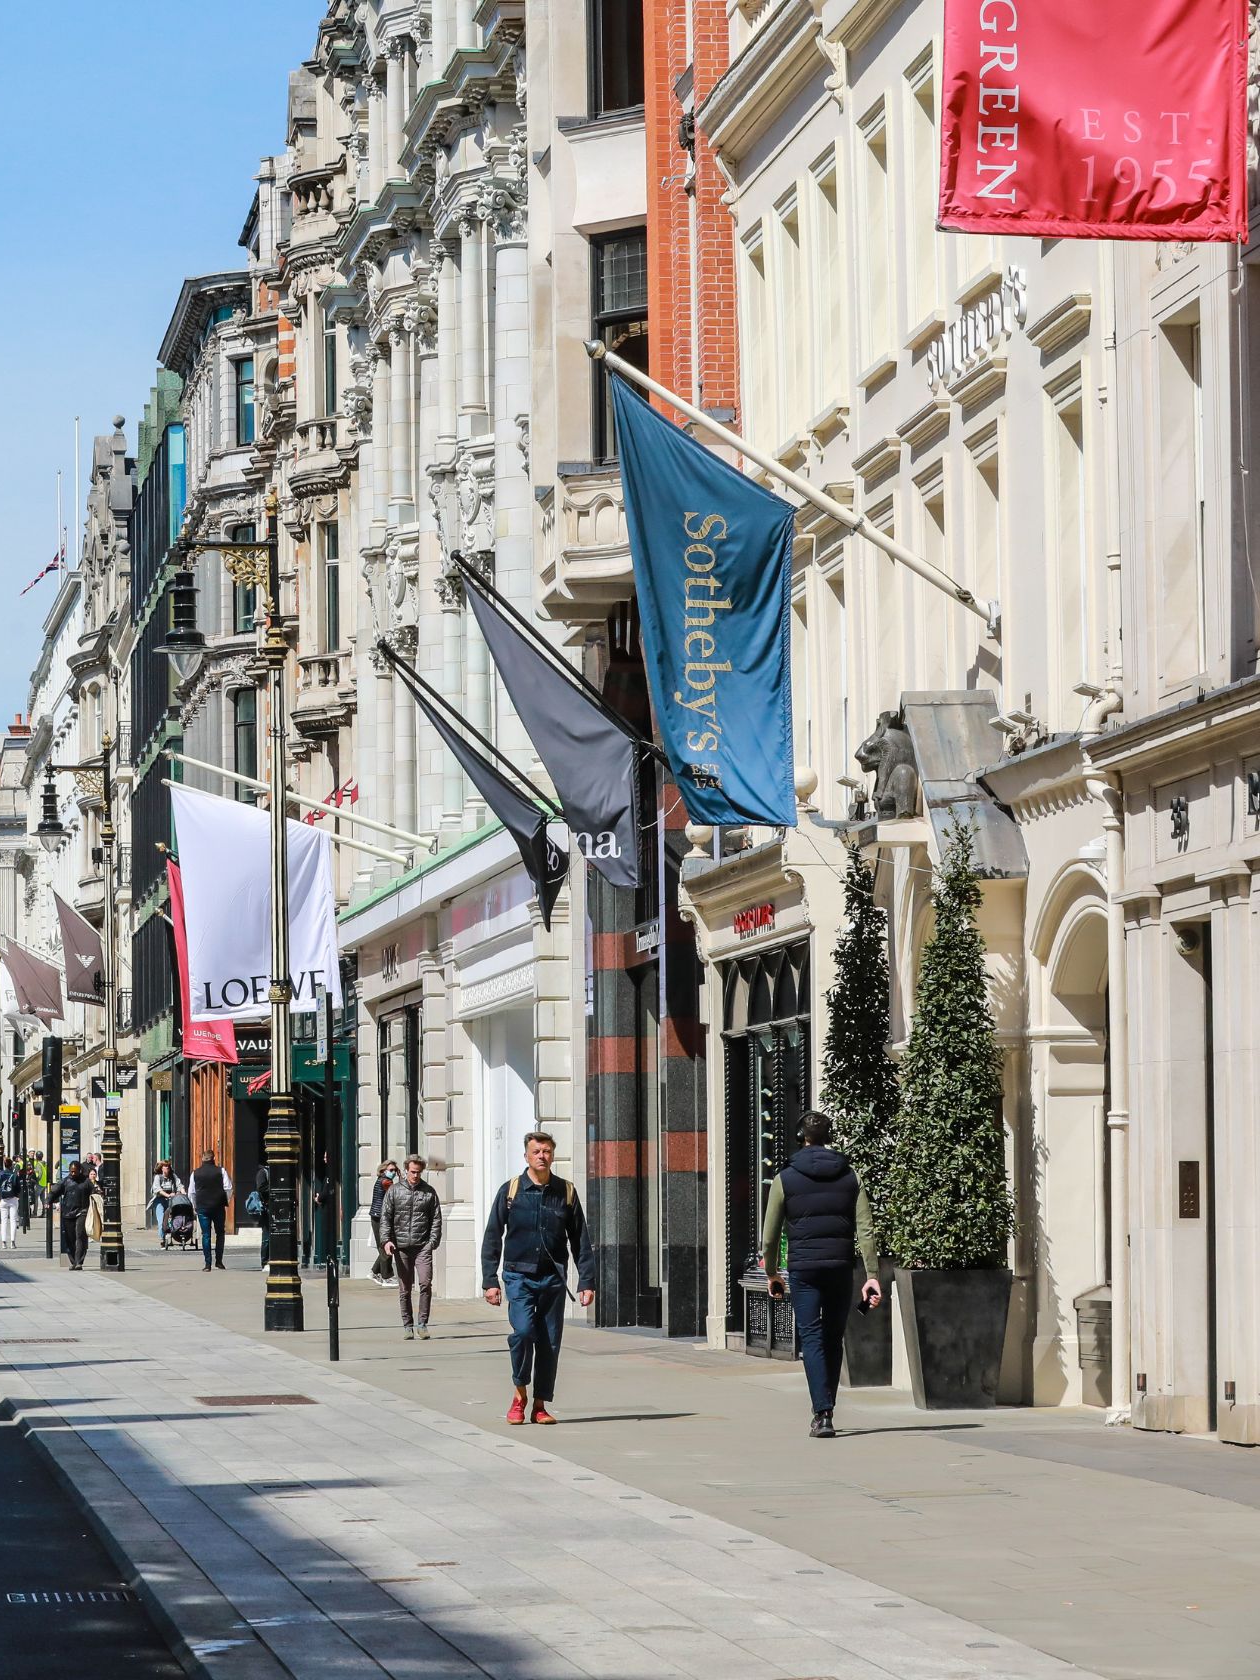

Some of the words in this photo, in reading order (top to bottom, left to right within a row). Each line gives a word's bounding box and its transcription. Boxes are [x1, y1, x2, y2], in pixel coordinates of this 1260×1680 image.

[977, 0, 1019, 204] GREEN
[1080, 107, 1214, 145] EST.
[1079, 155, 1215, 208] 1955
[674, 511, 733, 752] Sotheby's
[690, 763, 720, 776] EST
[693, 776, 724, 789] 1744
